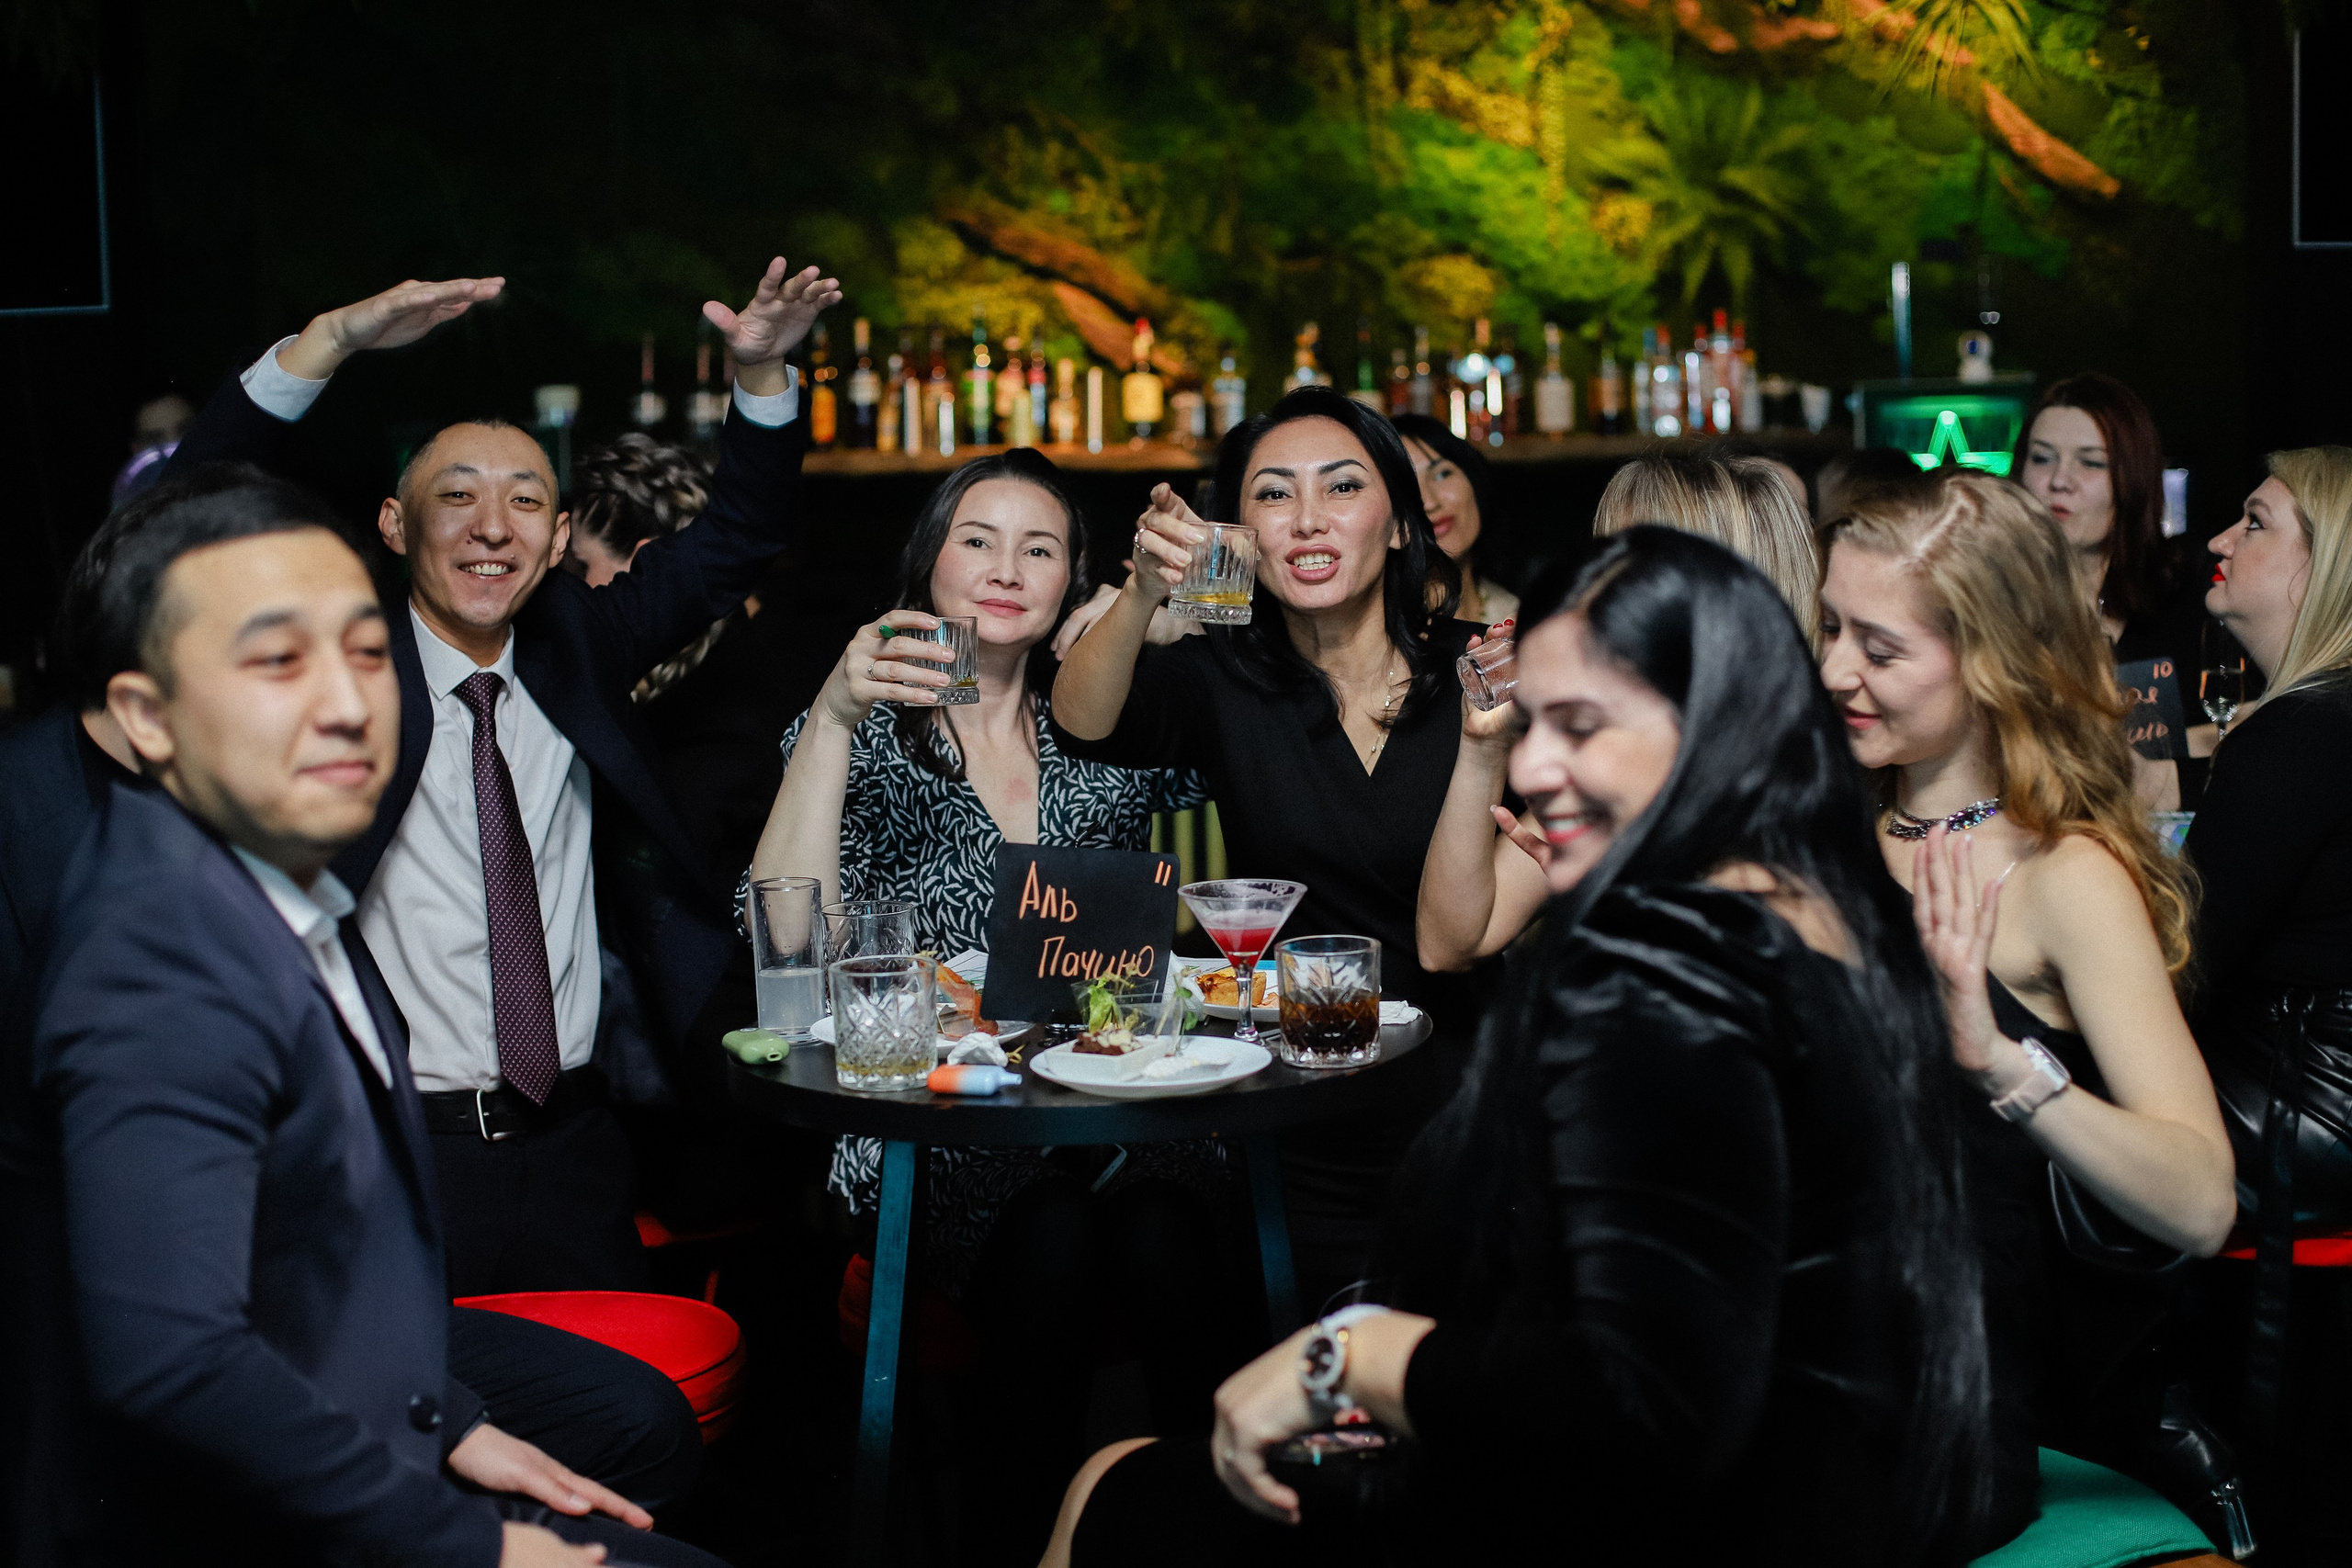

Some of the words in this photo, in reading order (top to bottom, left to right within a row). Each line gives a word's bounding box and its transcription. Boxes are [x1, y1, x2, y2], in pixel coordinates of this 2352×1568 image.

[2153, 660, 2174, 680] 10
[1018, 860, 1079, 923] Аль
[1037, 935, 1155, 981] Пачино
